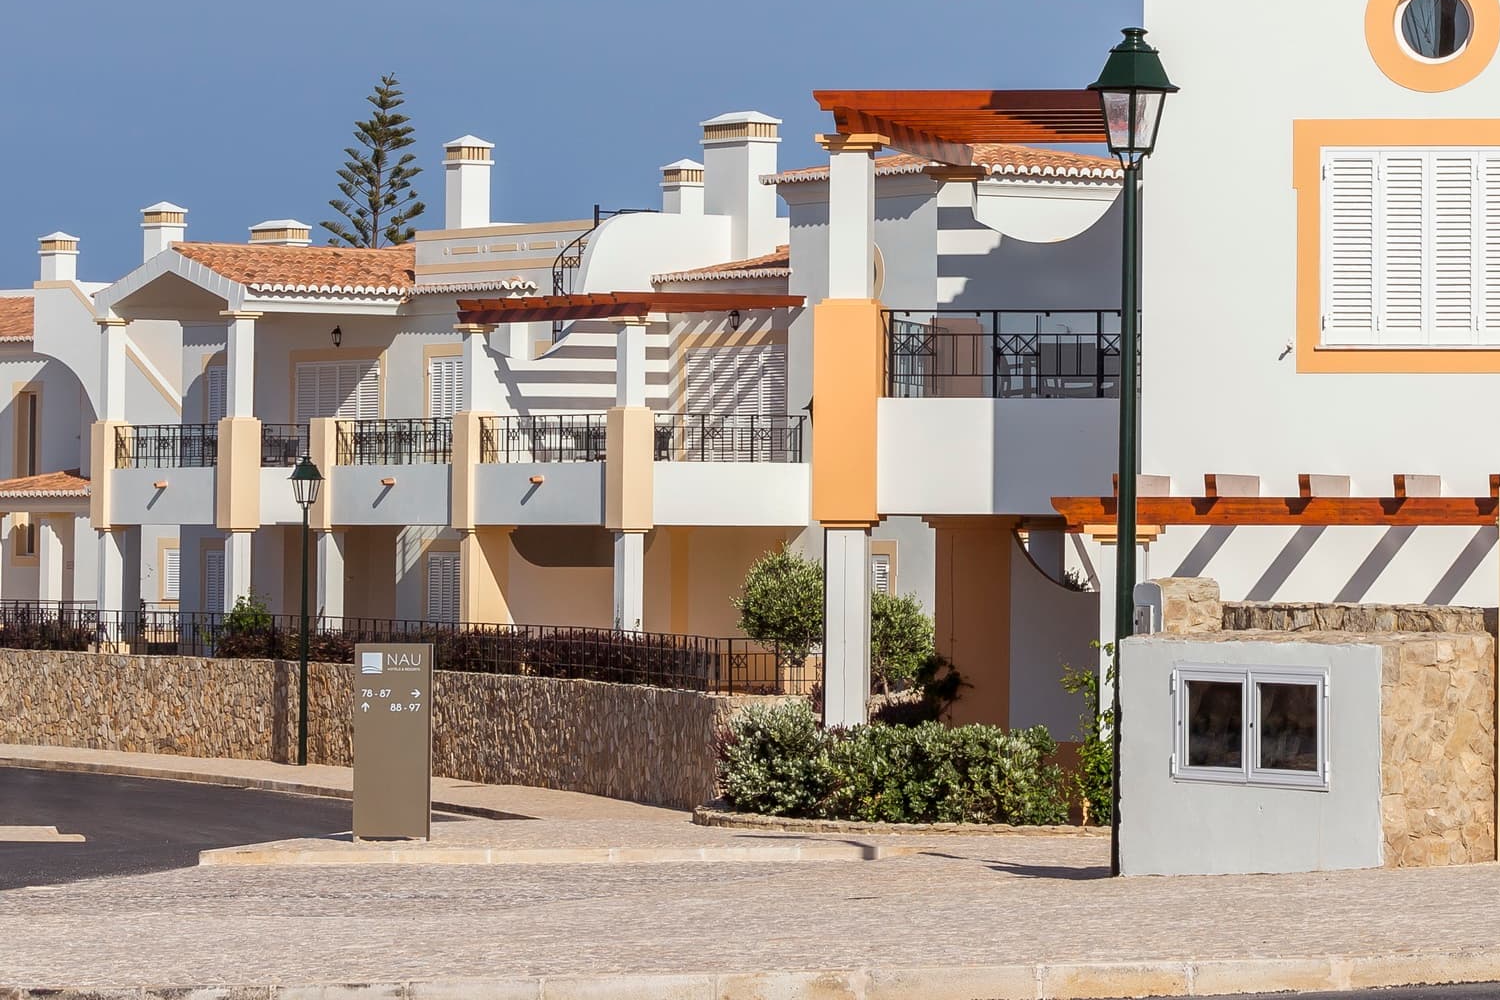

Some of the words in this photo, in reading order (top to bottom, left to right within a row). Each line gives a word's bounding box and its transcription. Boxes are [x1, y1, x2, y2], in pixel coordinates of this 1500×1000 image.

[387, 653, 421, 666] NAU
[361, 689, 373, 698] 78
[379, 689, 391, 698] 87
[390, 703, 402, 712] 88
[408, 703, 421, 712] 97
